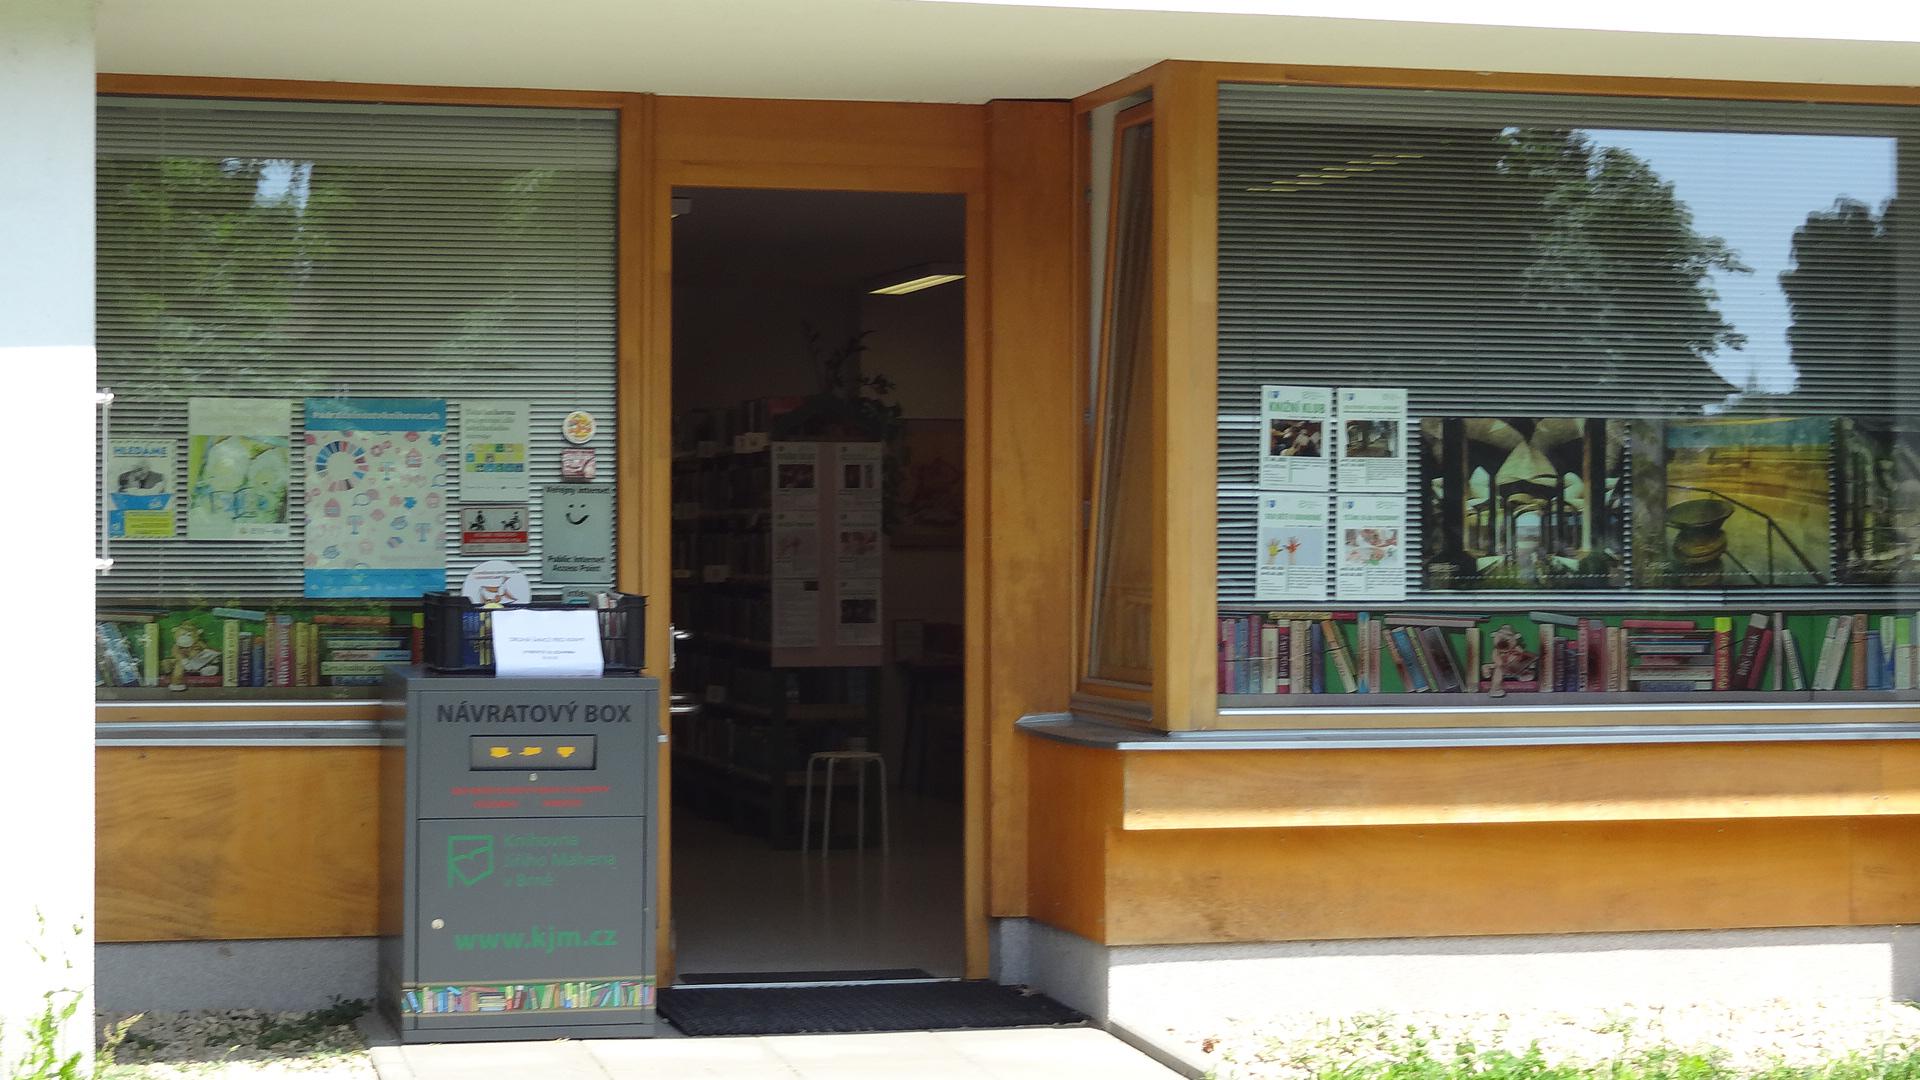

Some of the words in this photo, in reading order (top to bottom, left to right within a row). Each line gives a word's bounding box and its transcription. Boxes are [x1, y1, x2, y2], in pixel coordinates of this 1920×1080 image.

[437, 701, 578, 723] NÁVRATOVÝ
[584, 704, 632, 723] BOX
[504, 834, 579, 848] Knihovna
[455, 926, 618, 954] www.kjm.cz
